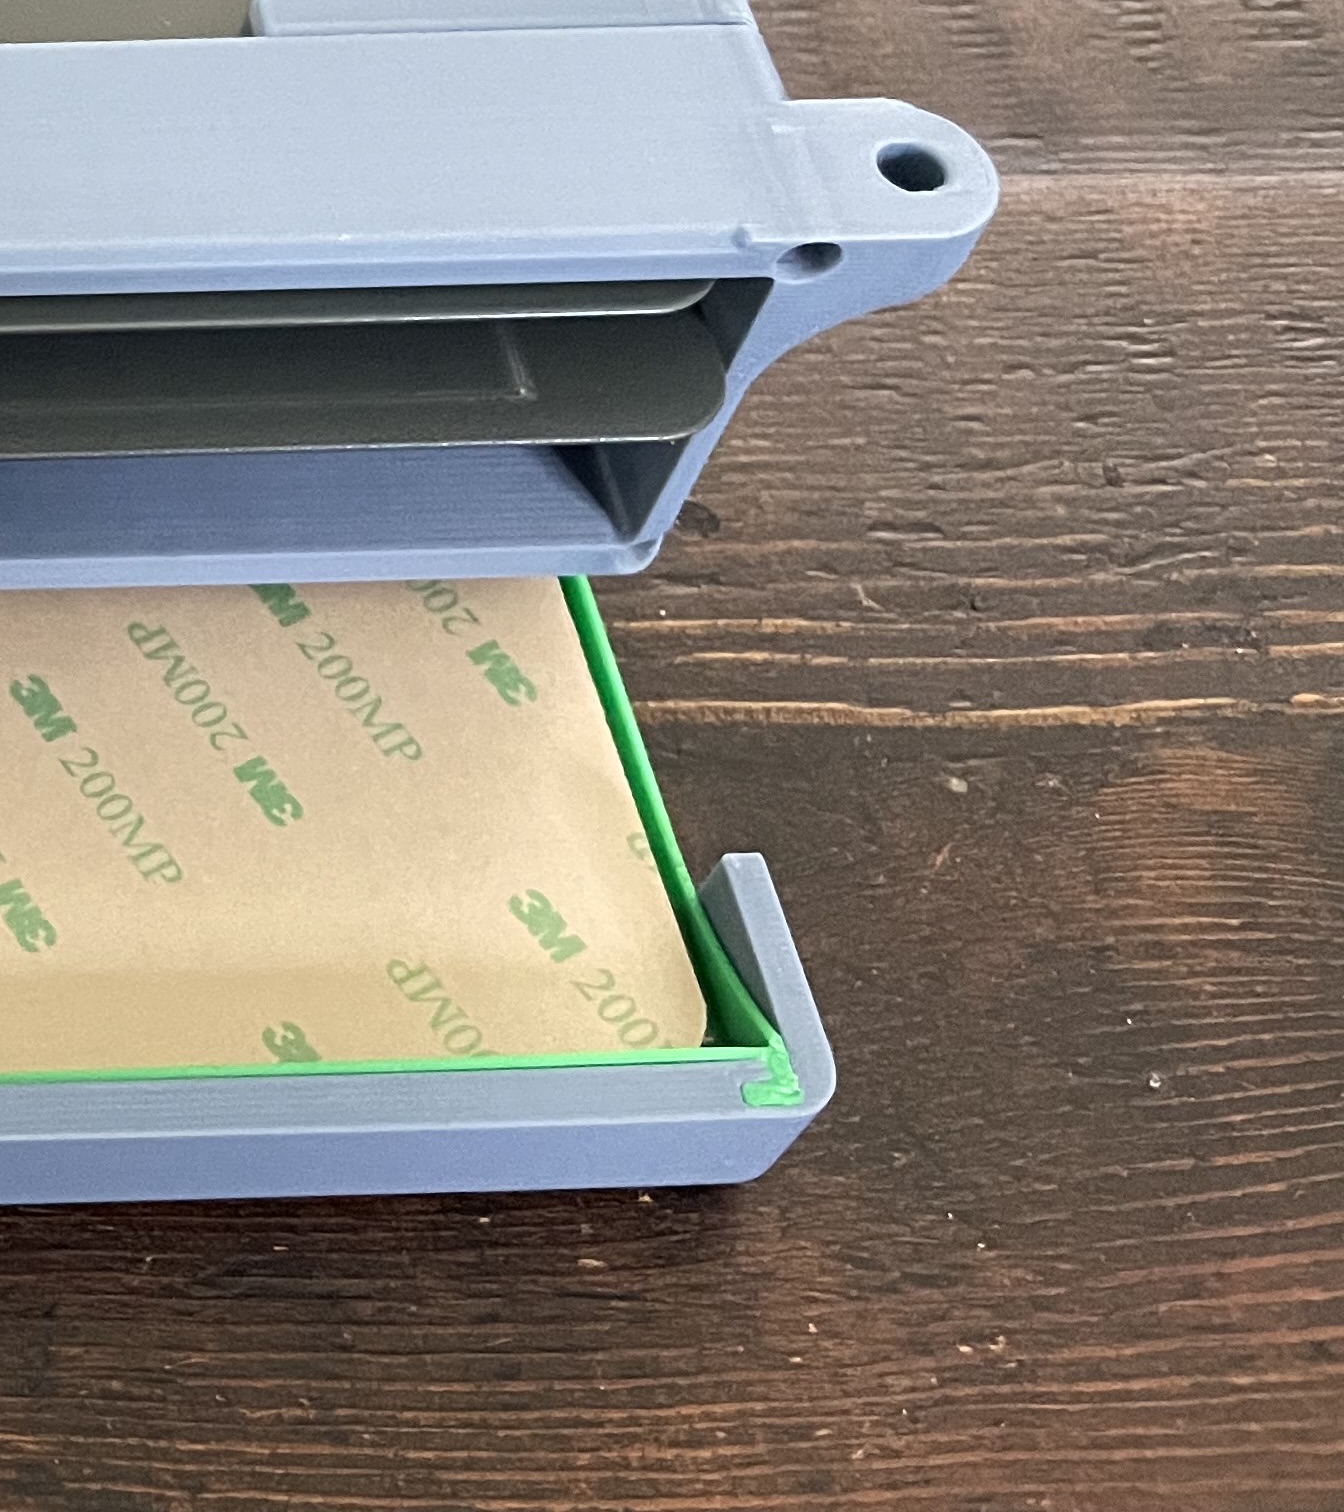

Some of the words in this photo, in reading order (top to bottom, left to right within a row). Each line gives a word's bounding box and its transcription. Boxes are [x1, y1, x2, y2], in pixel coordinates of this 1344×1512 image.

[405, 579, 482, 637] 200
[127, 620, 249, 752] 200MP
[296, 631, 424, 762] 200MP
[465, 639, 538, 708] 3M
[10, 674, 78, 743] 3M
[59, 746, 184, 885] 200MP
[233, 755, 303, 827] 3M
[386, 958, 502, 1057] 0MP
[509, 888, 587, 965] 3M
[571, 968, 662, 1049] 200
